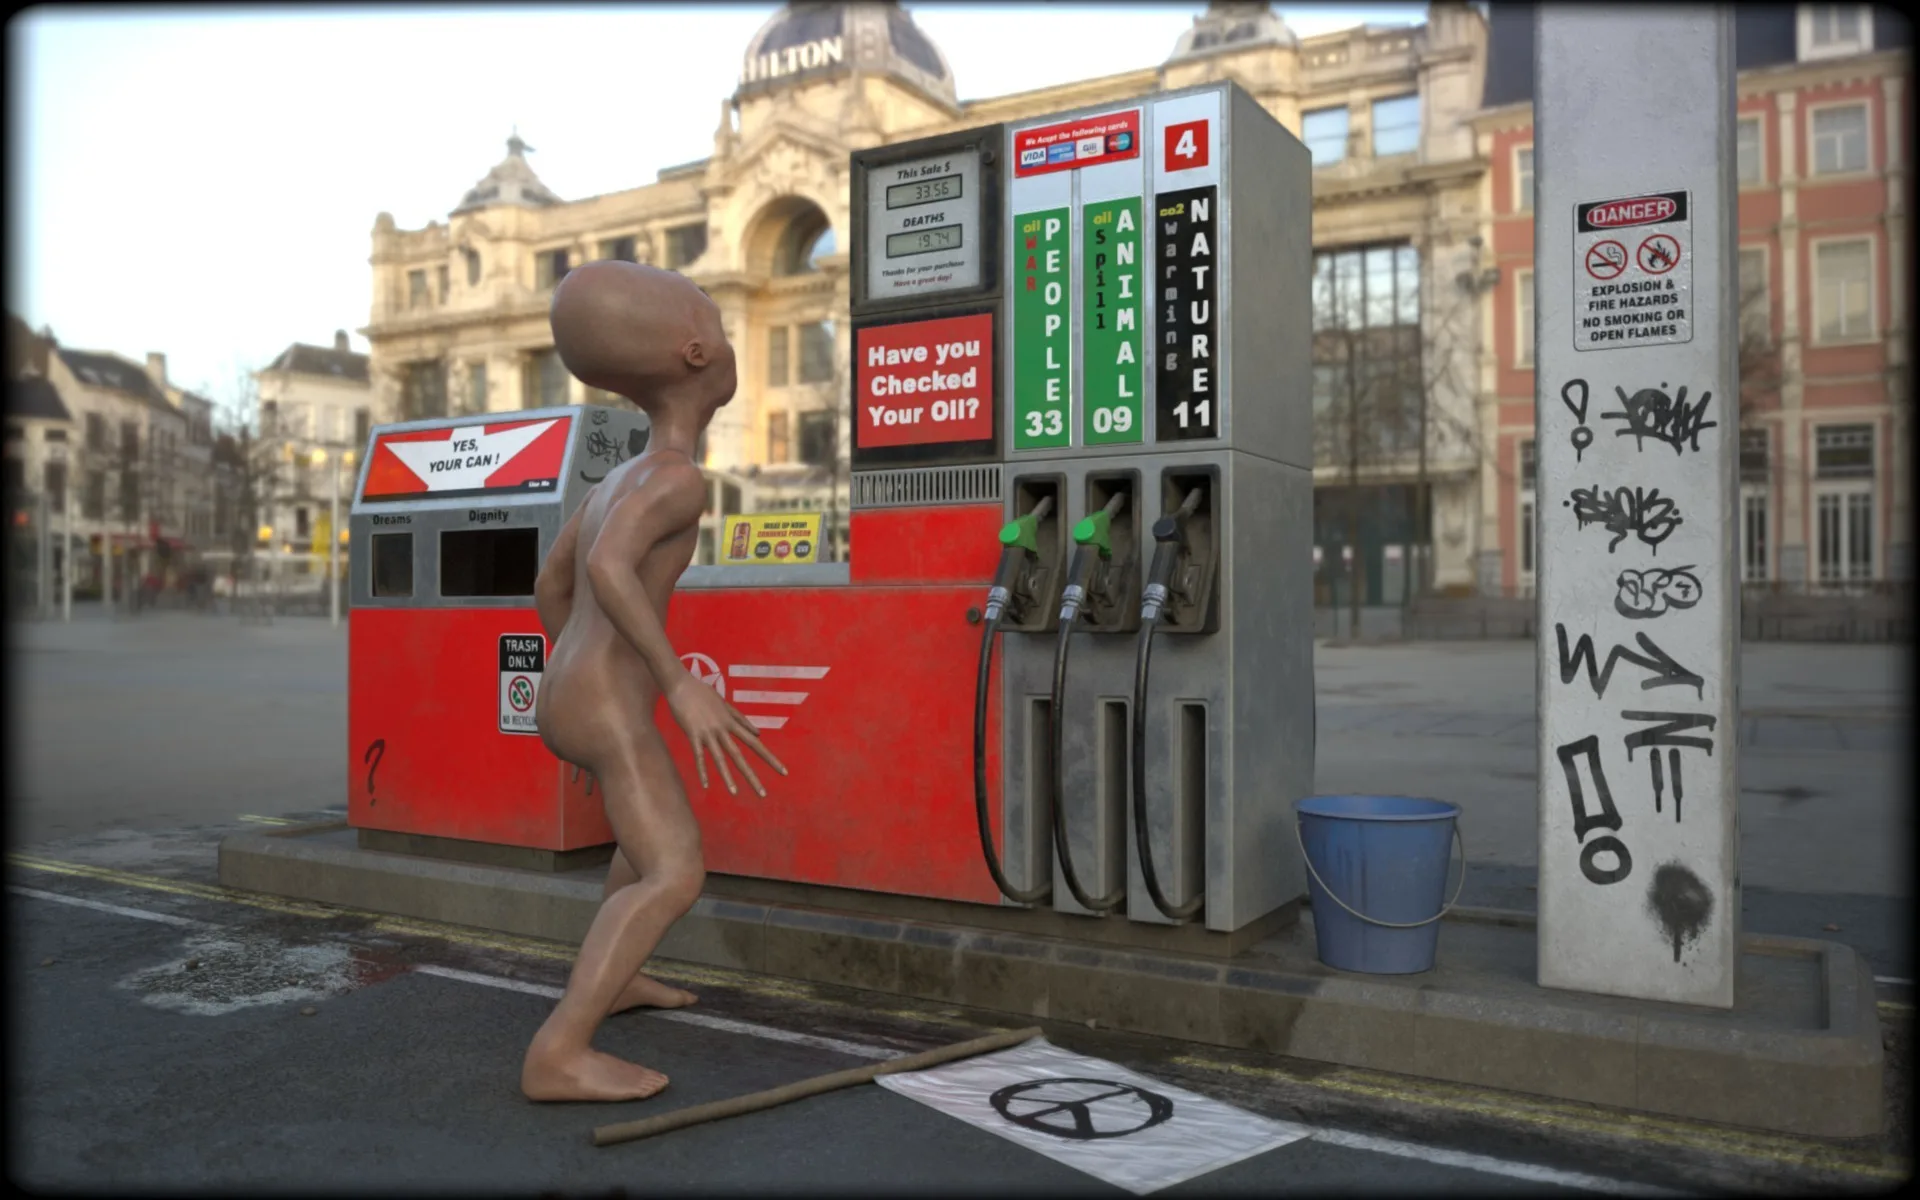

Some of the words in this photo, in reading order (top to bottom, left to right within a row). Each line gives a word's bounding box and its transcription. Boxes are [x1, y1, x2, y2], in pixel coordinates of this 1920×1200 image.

[1174, 129, 1197, 159] 4
[897, 169, 918, 180] This
[920, 164, 942, 176] Sale
[903, 212, 945, 228] DEATHS
[1093, 211, 1112, 225] oil
[1593, 200, 1671, 224] DANGER
[1023, 220, 1041, 233] oil
[906, 265, 916, 275] for
[918, 264, 933, 273] your
[934, 260, 965, 271] purchase
[1025, 236, 1037, 291] WAR
[1191, 198, 1210, 392] NATURE
[1592, 280, 1661, 297] EXPLOSION
[1666, 279, 1674, 290] &
[1045, 218, 1062, 401] PEOPLE
[1116, 209, 1135, 397] ANIMAL
[1589, 299, 1615, 311] FIRE
[1619, 293, 1678, 309] HAZARDS
[1583, 317, 1601, 328] NO
[1604, 311, 1663, 326] SMOKING
[1666, 309, 1685, 320] OR
[1590, 329, 1624, 341] OPEN
[1628, 324, 1677, 338] FLAMES
[868, 346, 928, 367] Have
[935, 340, 980, 365] you
[871, 366, 977, 396] Checked
[868, 406, 924, 427] Your
[931, 397, 980, 422] Oil?
[1093, 406, 1133, 434] 09
[1173, 400, 1210, 428] 11
[1025, 410, 1063, 437] 33
[453, 438, 479, 453] YES,
[429, 457, 462, 473] YOUR
[466, 455, 492, 468] CAN
[373, 514, 412, 525] Dreams
[469, 509, 509, 524] Dignity
[505, 639, 539, 652] TRASH
[508, 655, 536, 668] ONLY
